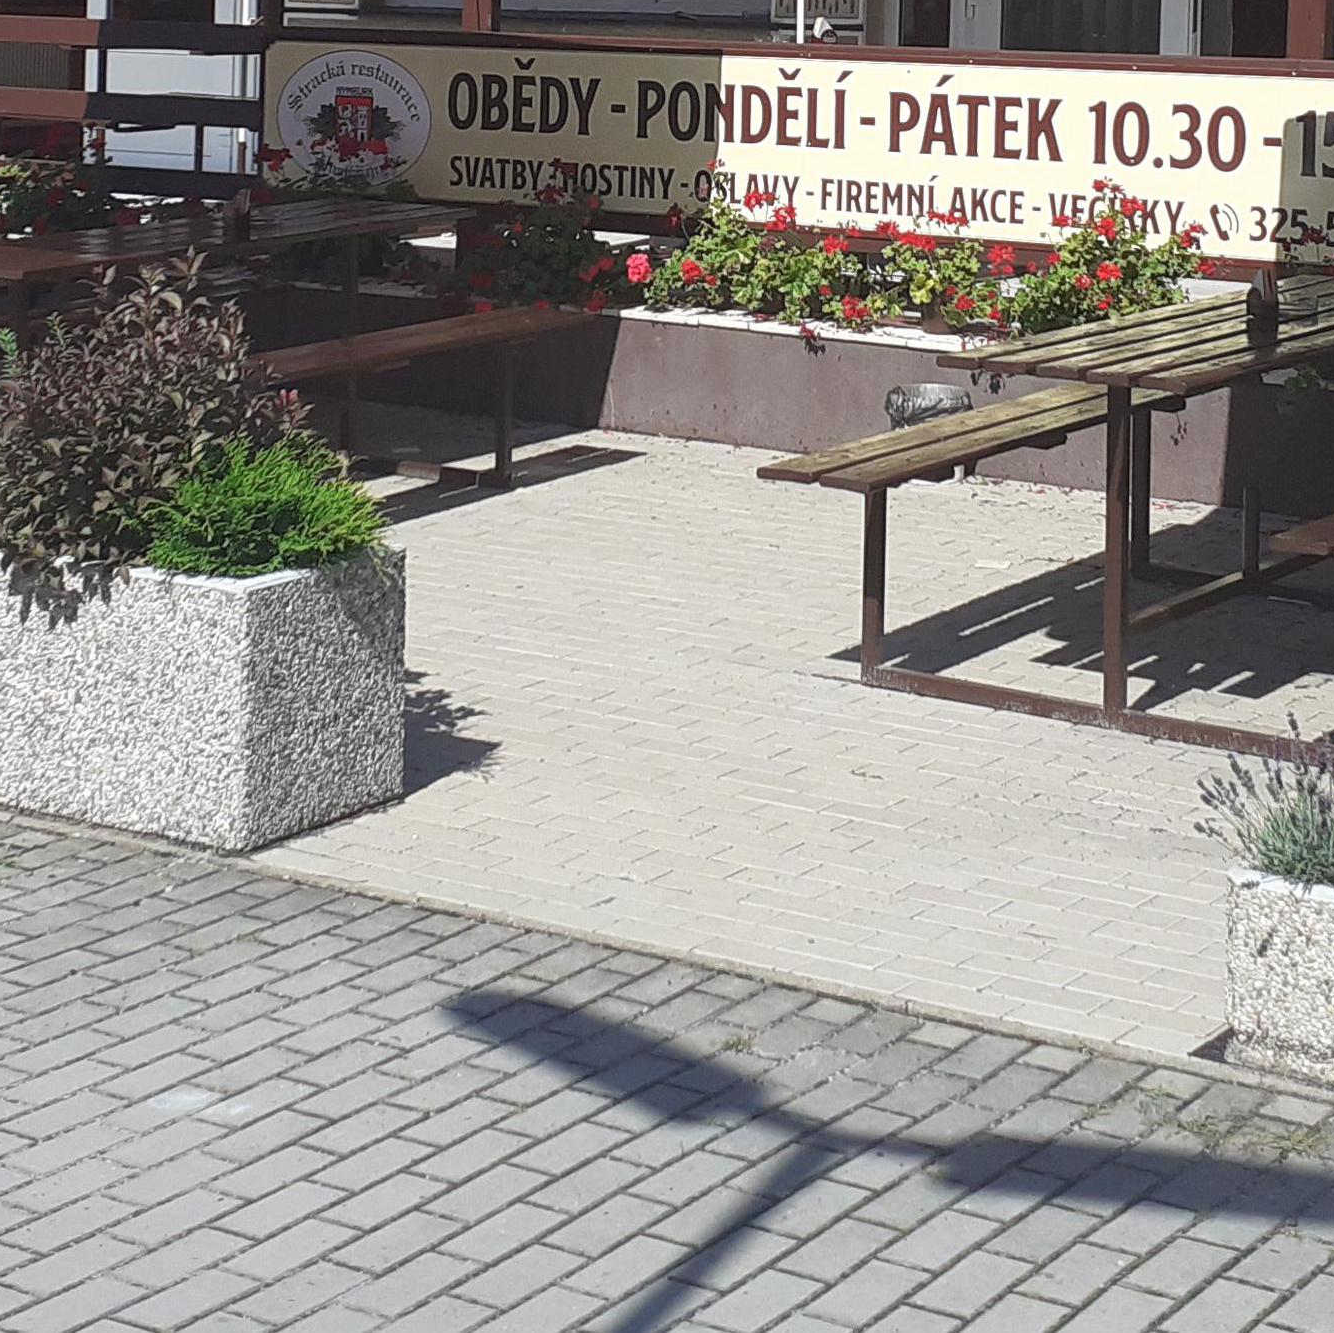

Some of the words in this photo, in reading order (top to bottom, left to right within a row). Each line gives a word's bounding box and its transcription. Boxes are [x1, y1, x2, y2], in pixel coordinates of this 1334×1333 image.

[286, 60, 346, 117] Stracká
[350, 62, 421, 123] restaurace
[448, 56, 601, 135] OBĚDY
[635, 68, 854, 150] PONDĚLÍ
[887, 74, 1064, 162] PÁTEK
[1088, 101, 1247, 172] 10.30
[449, 155, 544, 191] SVATBY
[820, 175, 937, 218] FIREMNÍ
[951, 186, 1025, 224] AKCE
[1248, 206, 1309, 244] 325
